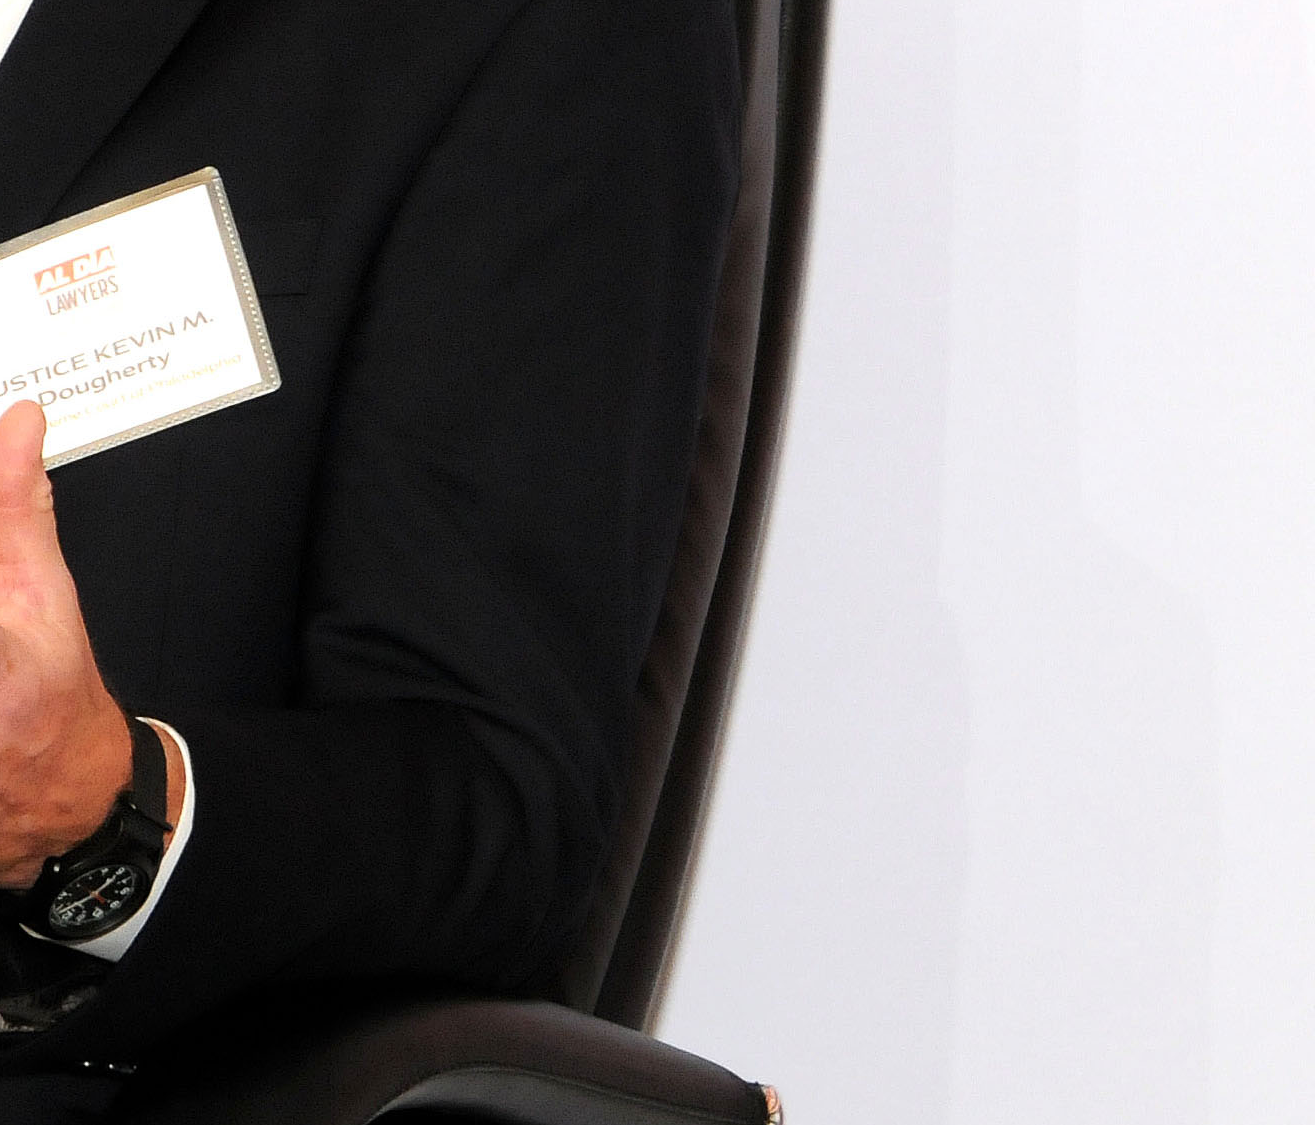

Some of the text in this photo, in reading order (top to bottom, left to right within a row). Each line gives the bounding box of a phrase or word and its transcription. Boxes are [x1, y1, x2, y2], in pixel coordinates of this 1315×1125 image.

[46, 275, 119, 316] LAWYERS
[94, 322, 176, 363] KEVIN
[182, 311, 214, 331] M.
[37, 352, 170, 407] Dougherty
